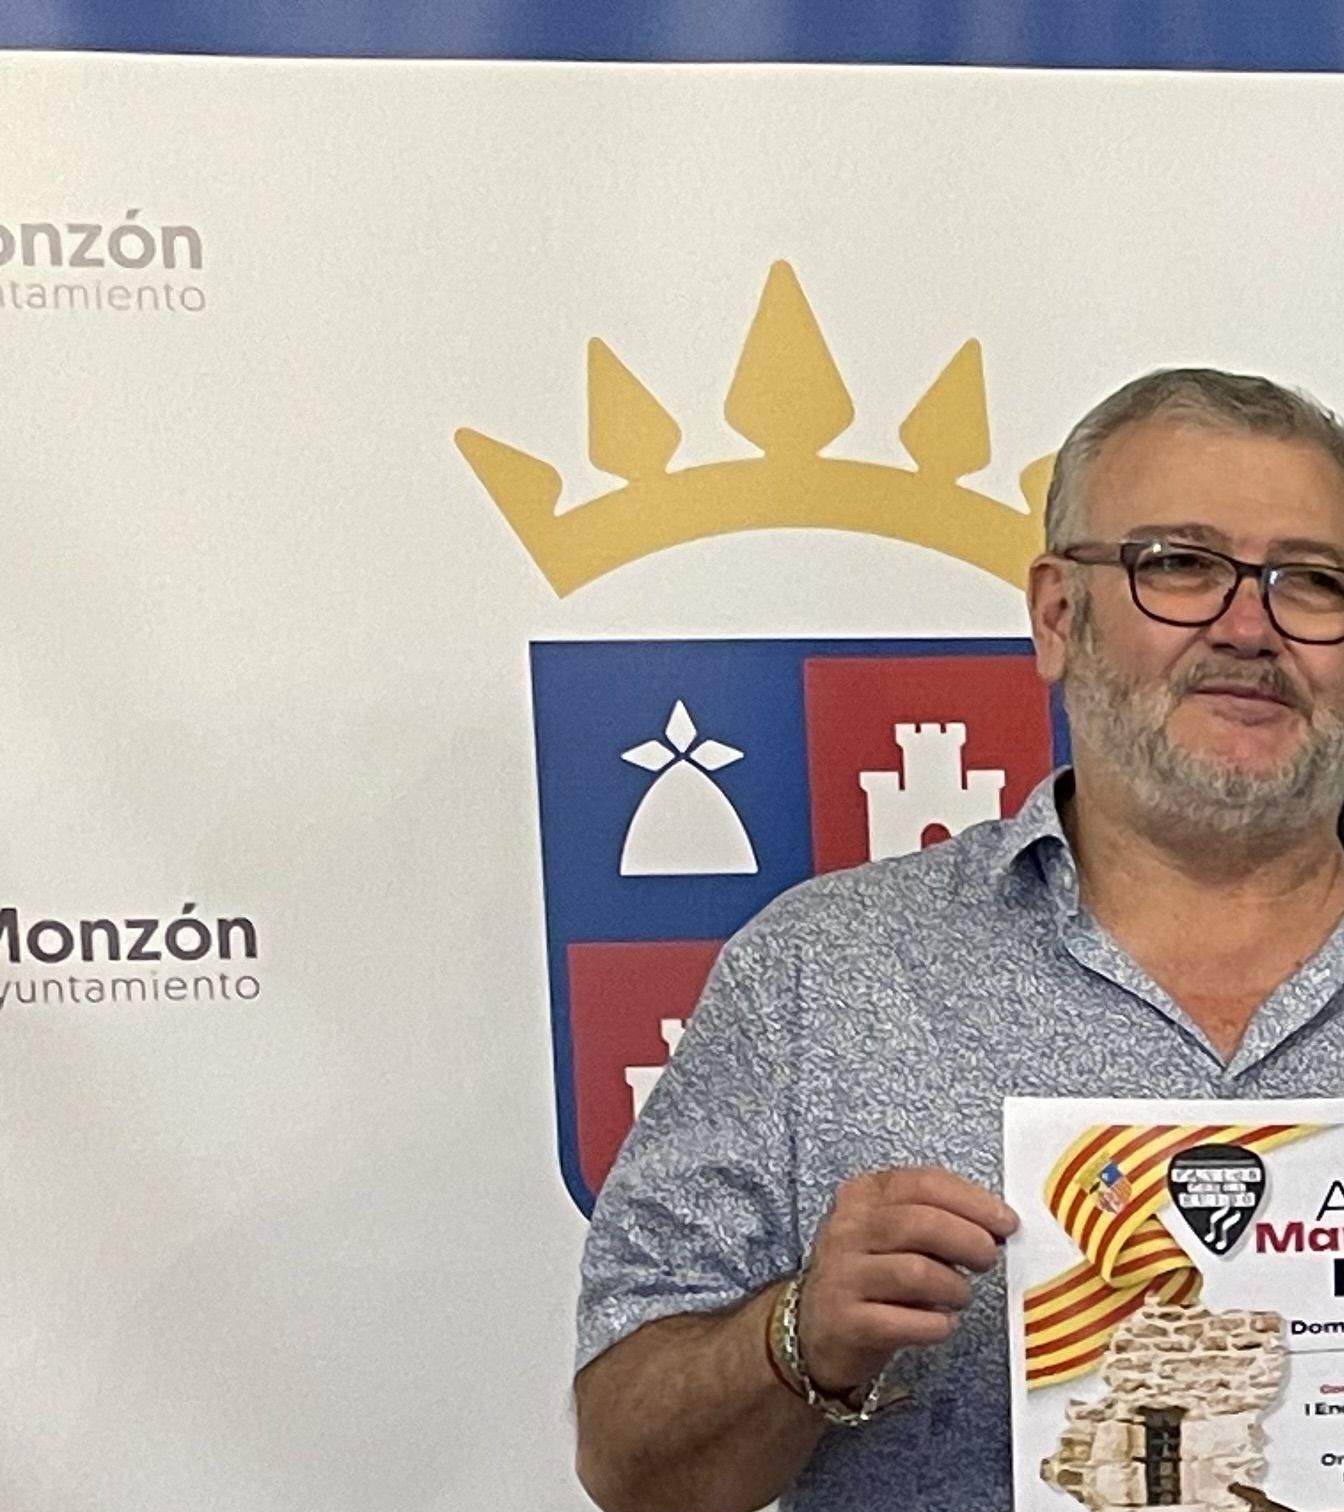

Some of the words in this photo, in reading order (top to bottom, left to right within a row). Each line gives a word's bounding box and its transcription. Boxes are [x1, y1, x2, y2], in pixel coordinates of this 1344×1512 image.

[0, 209, 203, 269] nzón
[0, 280, 206, 312] tamiento
[0, 902, 257, 963] onzón
